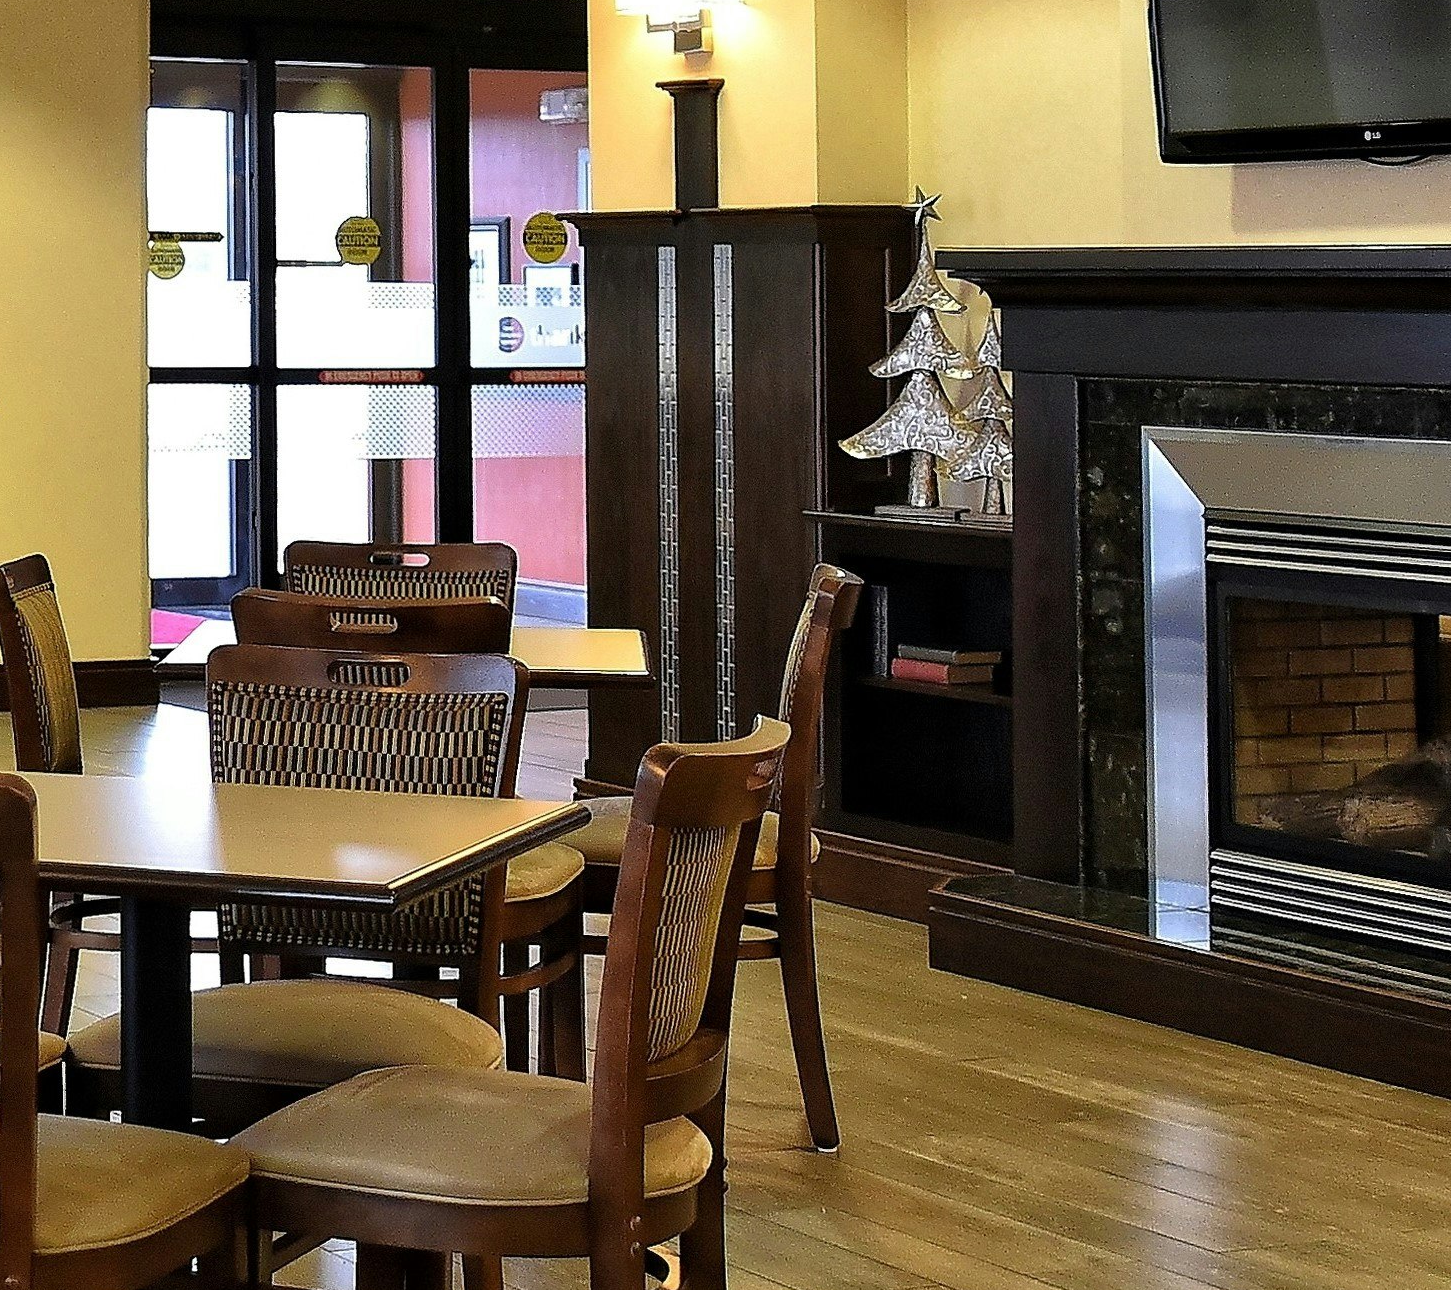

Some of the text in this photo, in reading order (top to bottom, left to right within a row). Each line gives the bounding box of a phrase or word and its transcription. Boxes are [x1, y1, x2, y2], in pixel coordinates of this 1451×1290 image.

[338, 234, 379, 246] CAUTION
[525, 232, 566, 244] CAUTION
[149, 254, 184, 264] CAUTION
